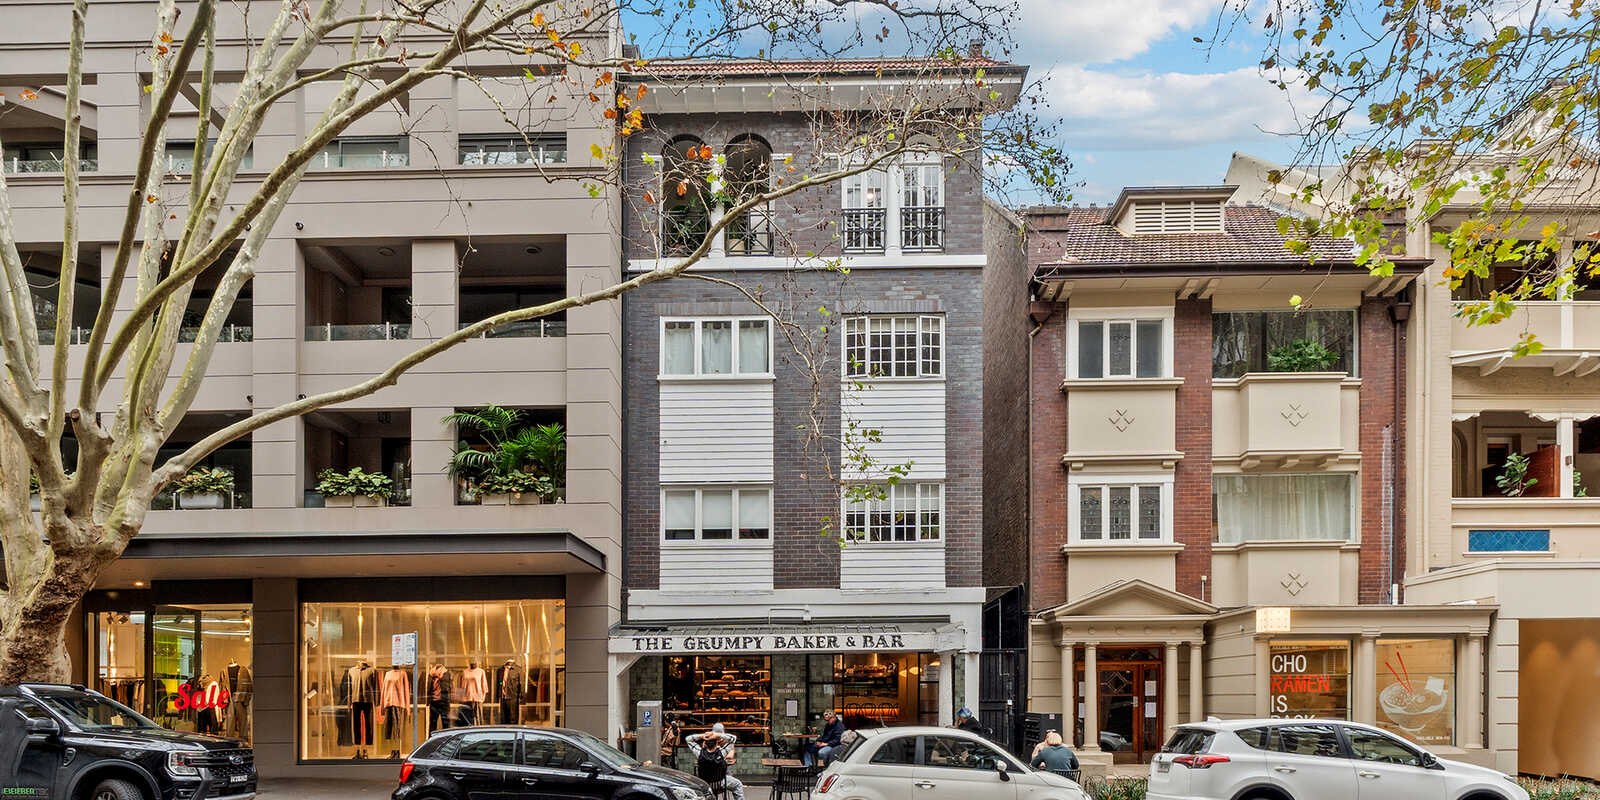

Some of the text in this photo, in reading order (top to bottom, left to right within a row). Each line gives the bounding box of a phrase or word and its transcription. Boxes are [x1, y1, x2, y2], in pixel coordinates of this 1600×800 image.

[632, 634, 904, 650] THE GRUMPY BAKER & BAR
[1272, 654, 1307, 673] CHO
[1272, 675, 1330, 693] RAMEN
[174, 683, 229, 710] Sale
[1271, 695, 1288, 713] IS
